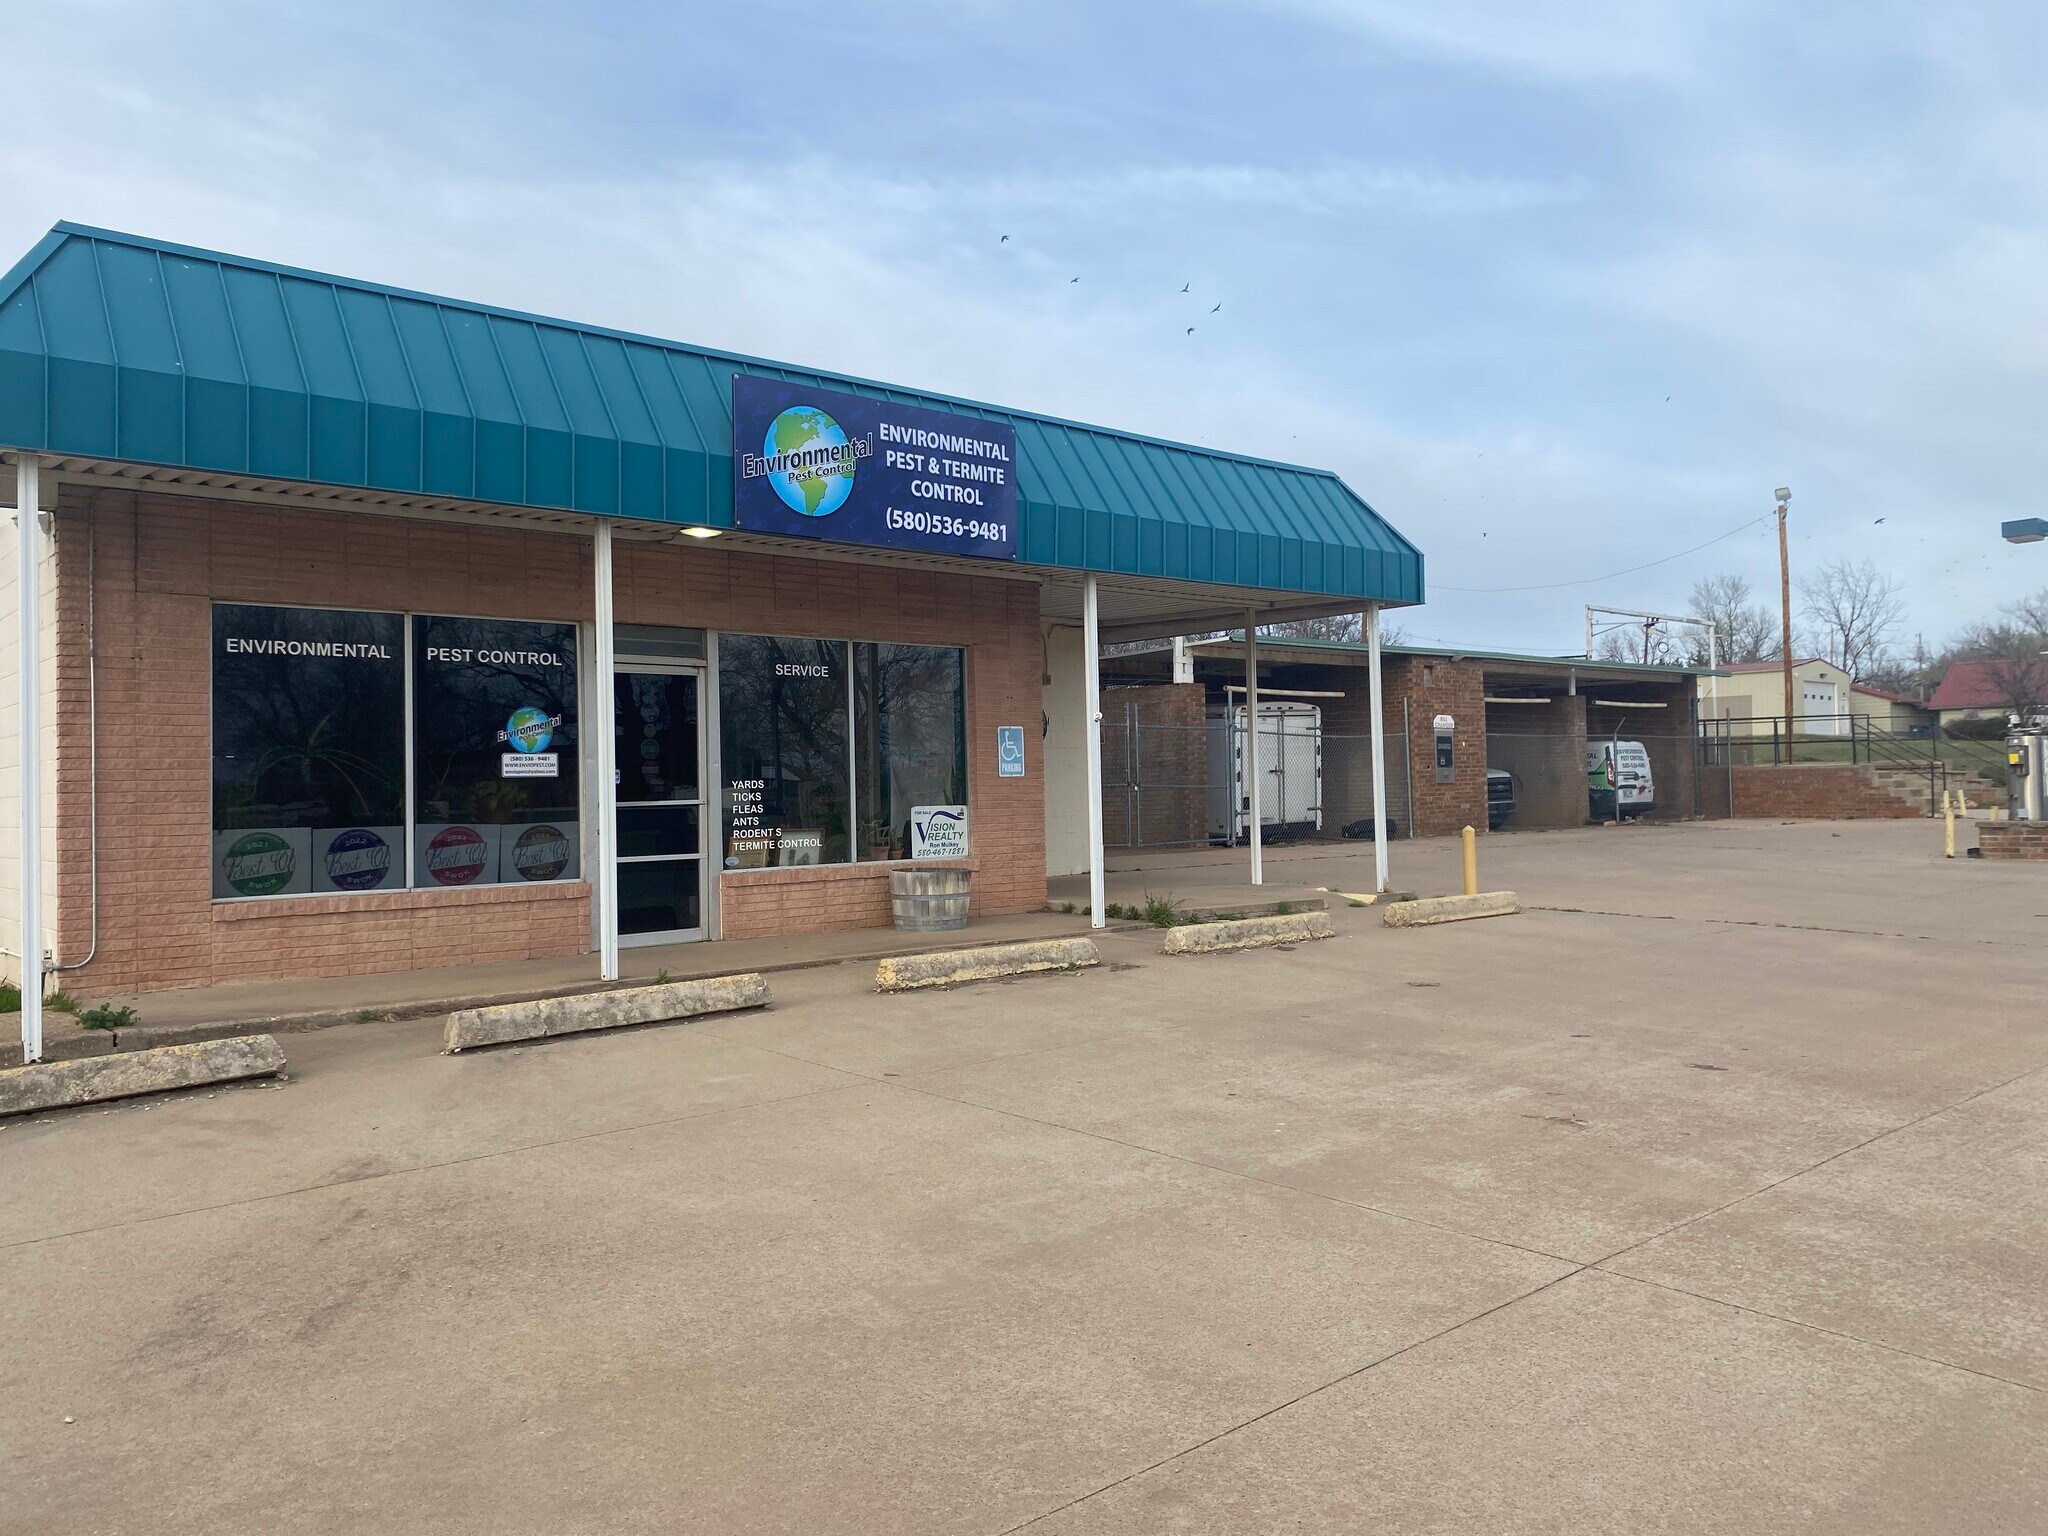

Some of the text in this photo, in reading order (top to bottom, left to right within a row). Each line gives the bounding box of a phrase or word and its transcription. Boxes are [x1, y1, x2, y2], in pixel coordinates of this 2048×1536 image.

[879, 423, 1010, 462] ENVIRONMENTAL
[742, 432, 873, 479] Environmental
[788, 459, 857, 484] Pest Control
[886, 450, 1005, 485] PEST & TERMITE
[911, 479, 984, 506] CONTROL
[886, 507, 1008, 542] (580)536-9481
[226, 638, 391, 660] ENVIRONMENTAL
[427, 647, 562, 667] PEST CONTROL
[775, 664, 829, 678] SERVICE
[498, 714, 561, 742] Environmental
[1001, 762, 1022, 773] PARKING
[732, 780, 765, 790] YARDS
[732, 792, 762, 801] TICKS
[732, 804, 764, 814] FLEAS
[732, 817, 759, 826] ANTS
[345, 837, 367, 847] 2022
[733, 838, 823, 851] TERMITE CONTROL
[927, 832, 964, 842] REALTY
[222, 853, 267, 881] Best
[324, 851, 362, 877] Best
[425, 846, 462, 871] Best
[512, 845, 547, 869] Best
[248, 877, 278, 889] SWOK
[346, 873, 374, 885] SWOK
